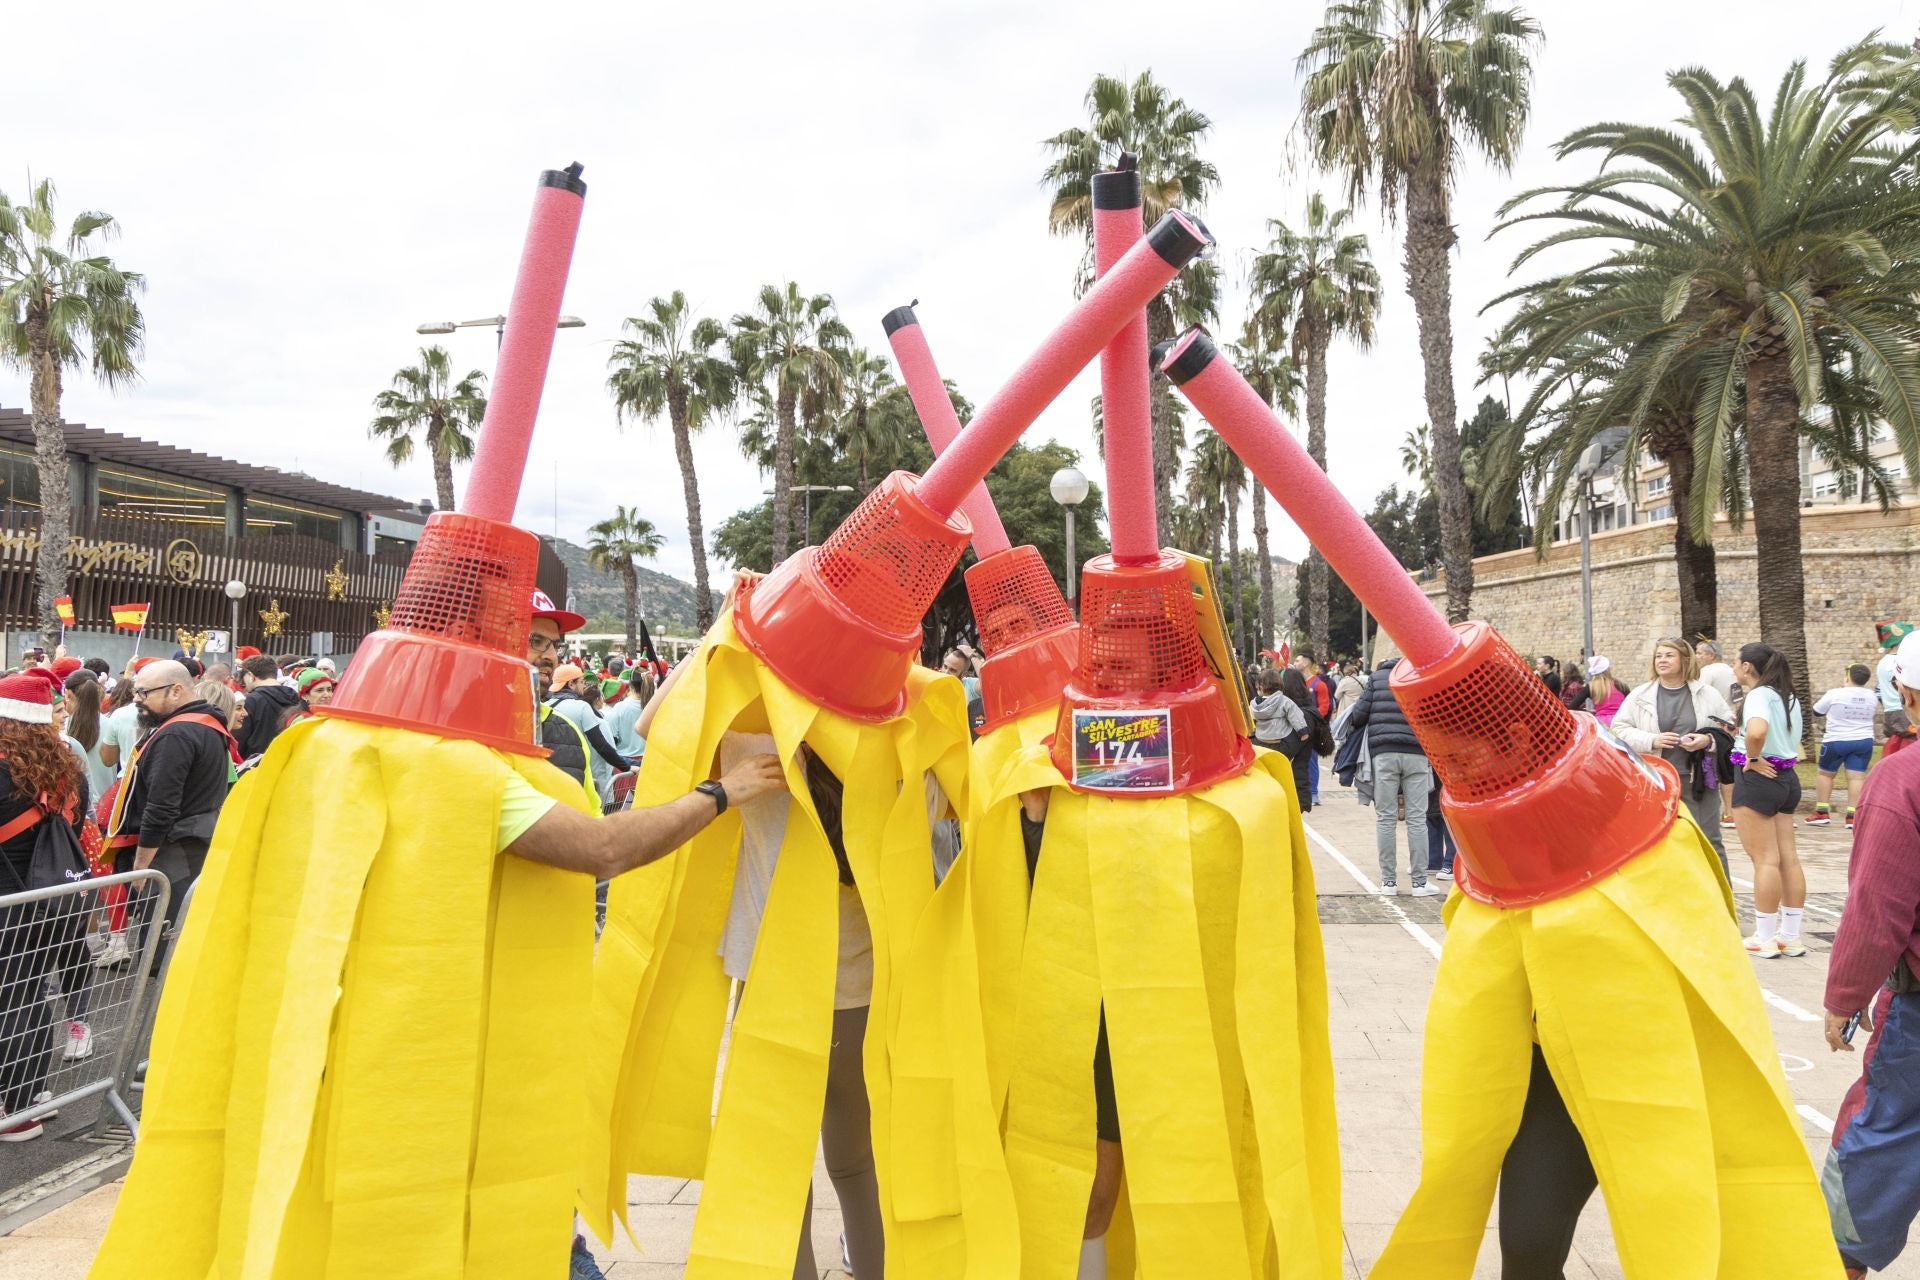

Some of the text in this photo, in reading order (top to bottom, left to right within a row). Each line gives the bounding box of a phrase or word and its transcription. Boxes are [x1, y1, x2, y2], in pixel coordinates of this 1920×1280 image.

[170, 550, 196, 573] 43
[536, 595, 553, 609] M
[1089, 719, 1116, 732] SAN
[1089, 717, 1159, 743] SILVESTRE
[1117, 728, 1160, 742] CARTAGENA
[1095, 741, 1144, 766] 174
